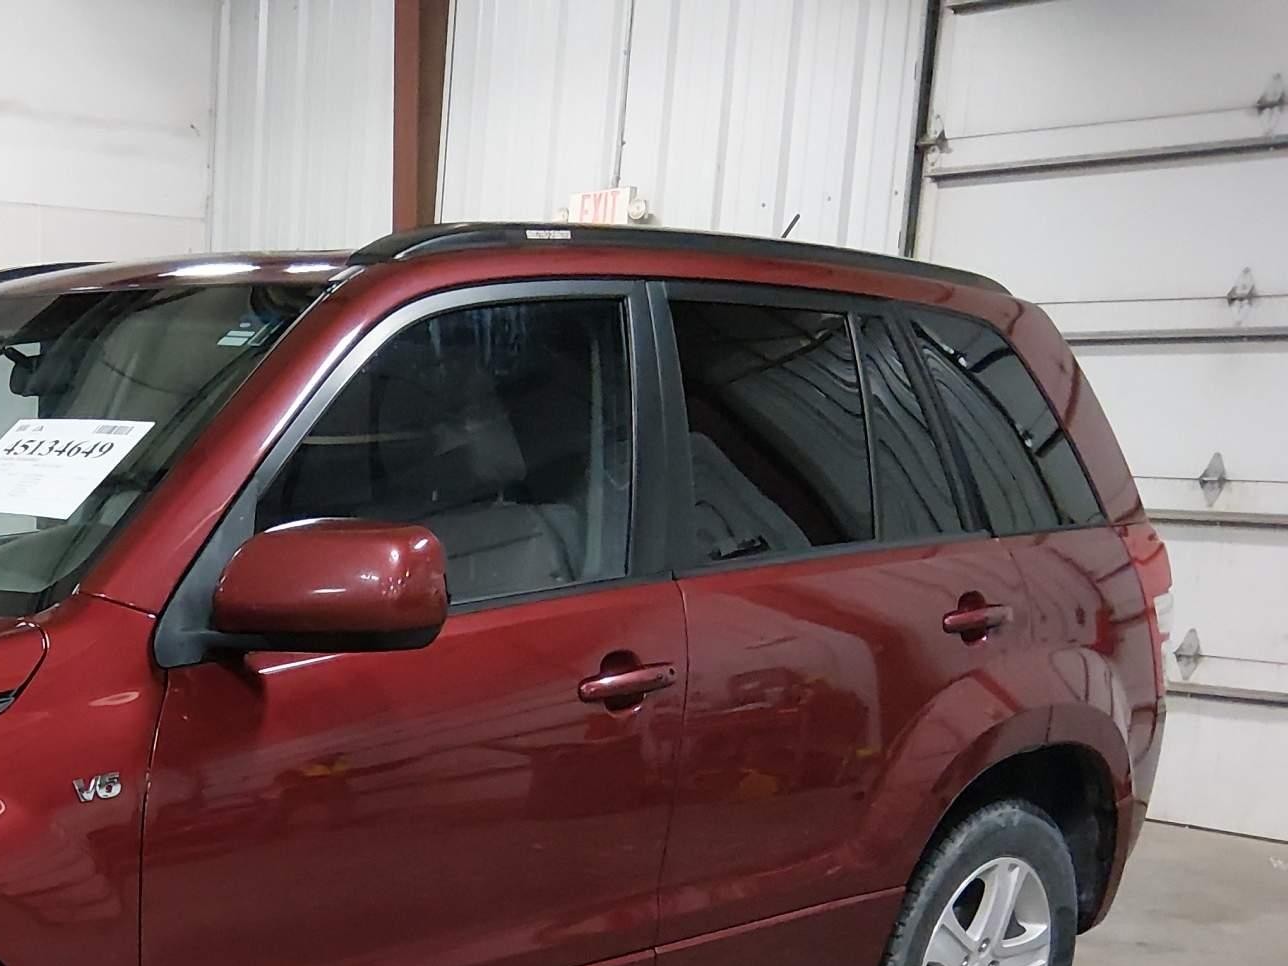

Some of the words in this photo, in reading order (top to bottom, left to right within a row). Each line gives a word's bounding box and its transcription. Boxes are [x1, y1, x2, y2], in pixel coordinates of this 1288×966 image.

[580, 190, 620, 223] EXIT
[3, 439, 114, 458] 45134649
[72, 771, 122, 802] V6
